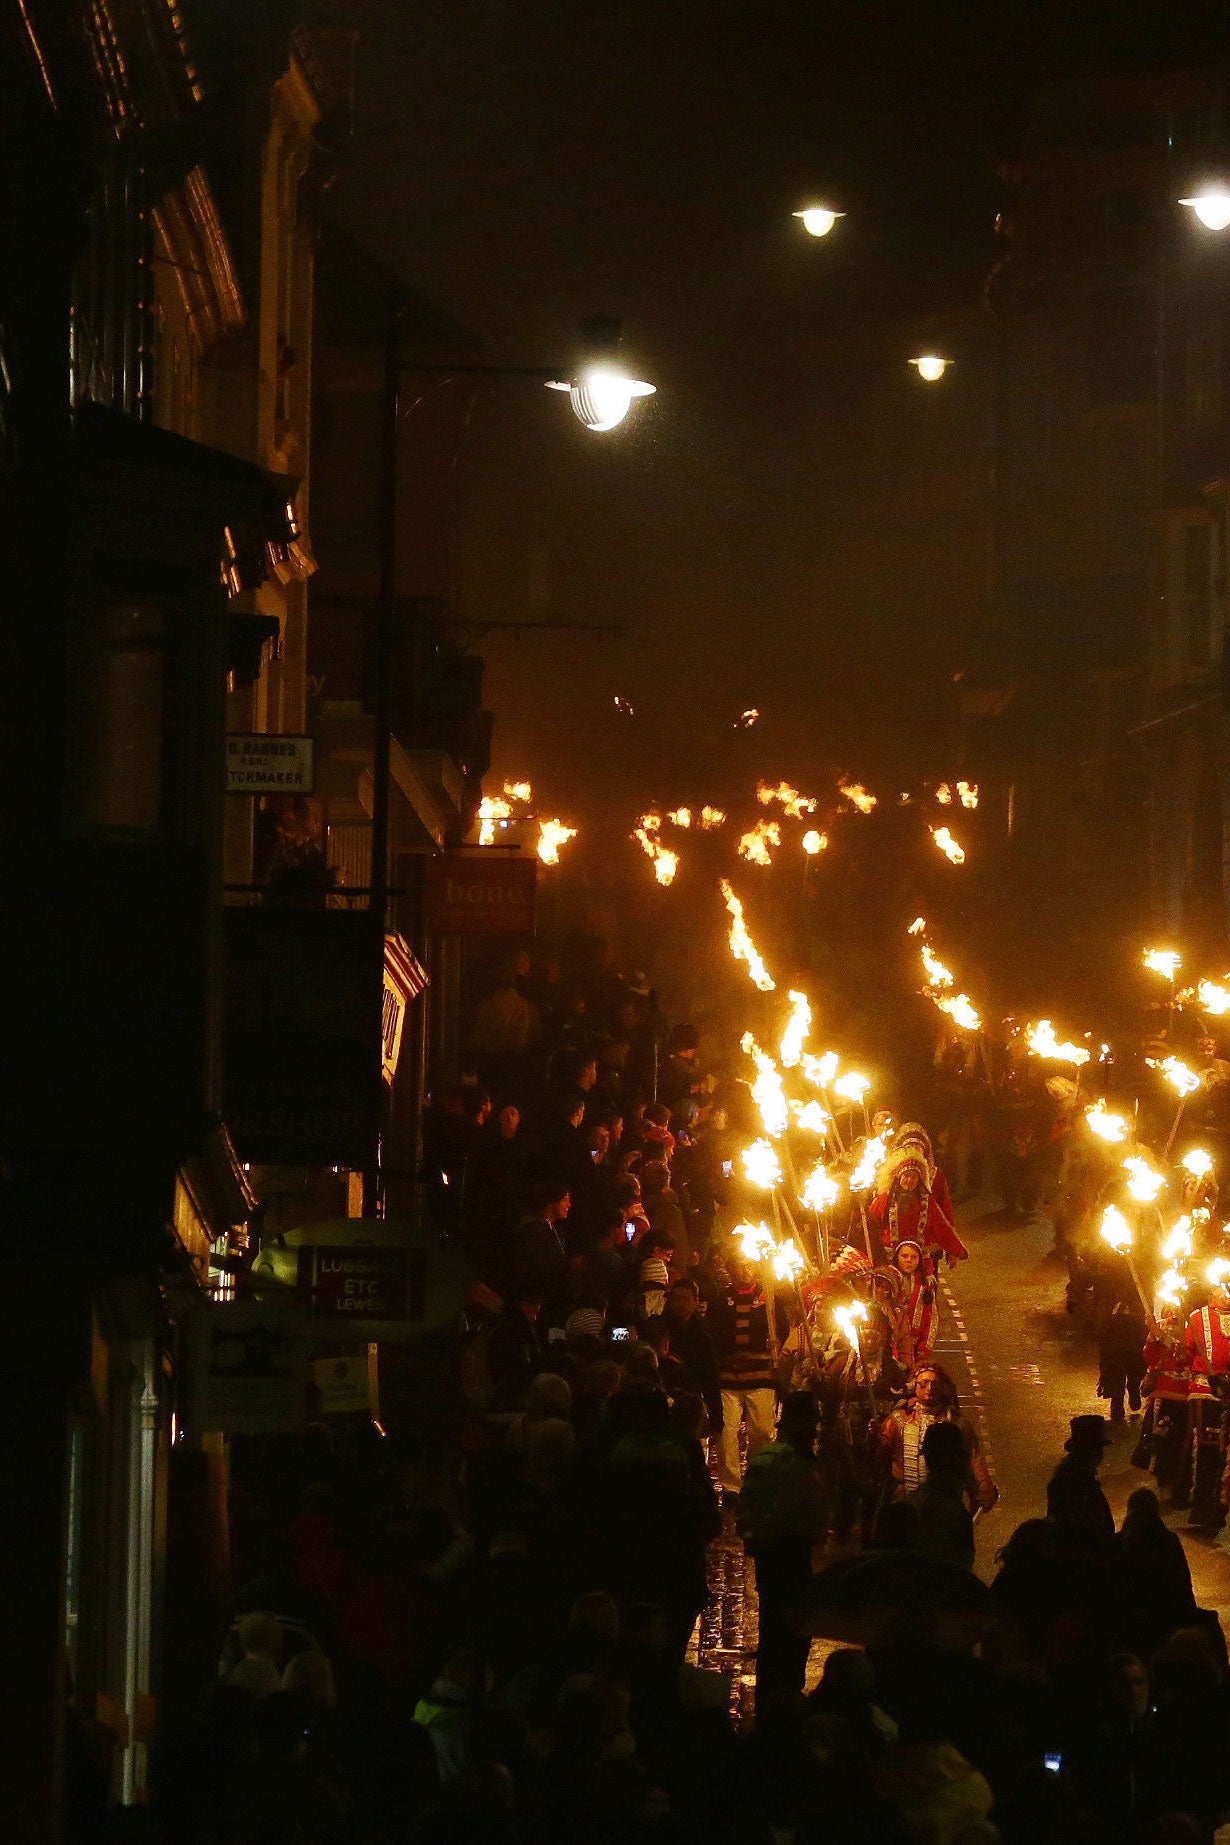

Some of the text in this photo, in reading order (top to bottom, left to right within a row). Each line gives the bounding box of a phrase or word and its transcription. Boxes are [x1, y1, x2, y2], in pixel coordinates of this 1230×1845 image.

[244, 742, 296, 755] BARNES
[227, 771, 302, 784] TCHMAKER
[344, 1278, 379, 1294] ETC
[337, 1298, 385, 1311] LEWES
